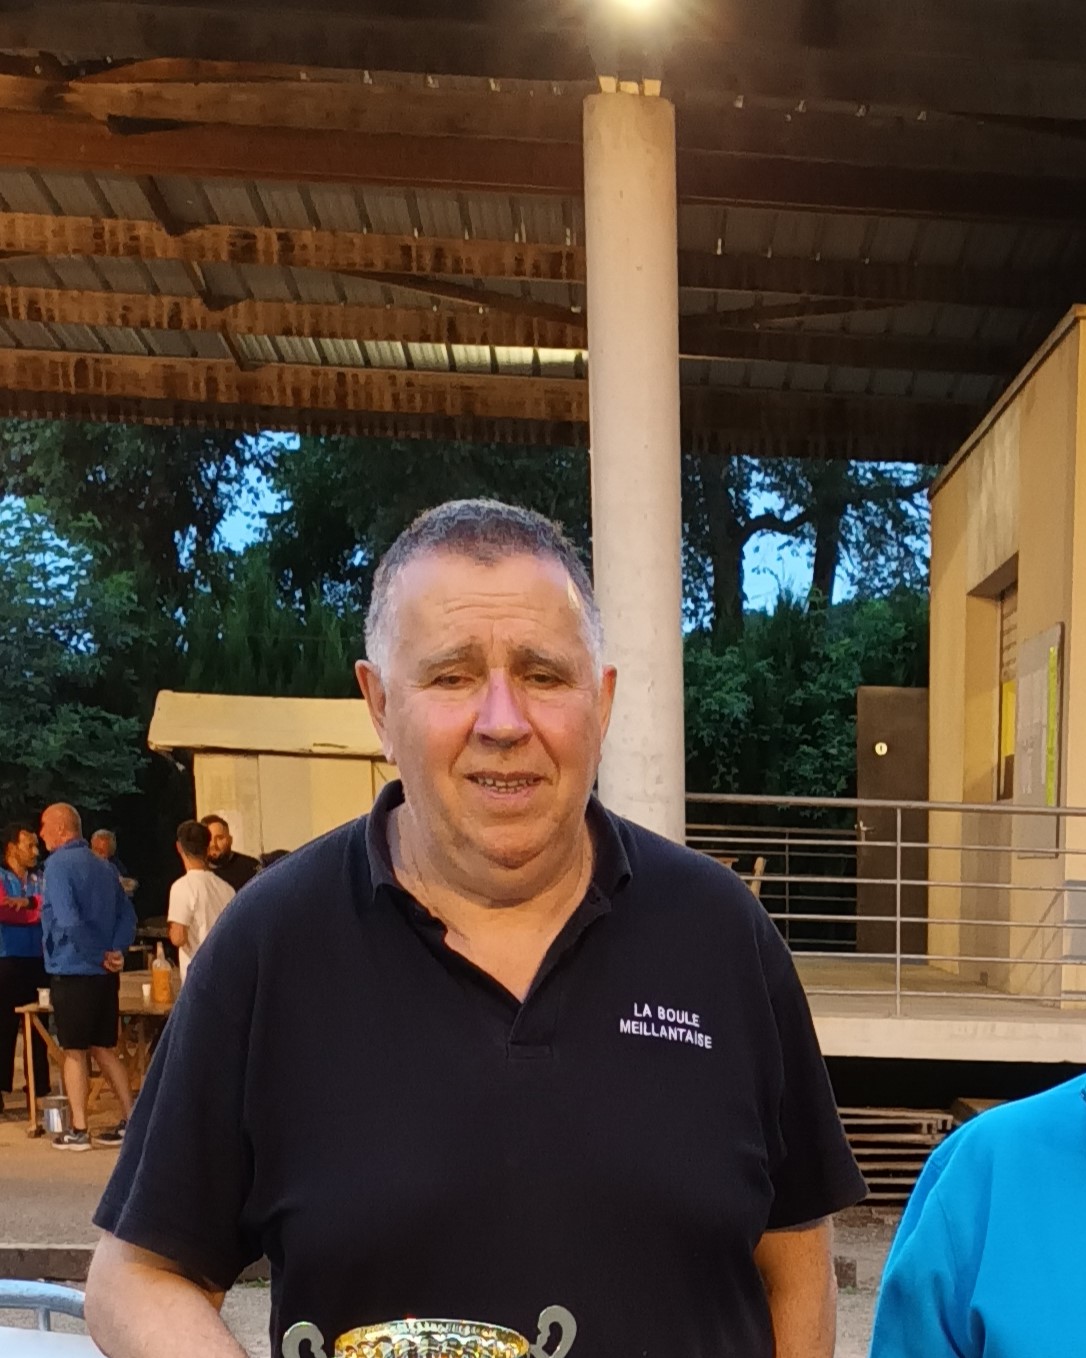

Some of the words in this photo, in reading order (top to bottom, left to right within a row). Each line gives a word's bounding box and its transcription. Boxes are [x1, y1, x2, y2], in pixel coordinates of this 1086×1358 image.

[633, 1002, 652, 1018] LA
[657, 1005, 700, 1028] BOULE
[619, 1018, 713, 1049] MEILLANTAISE
